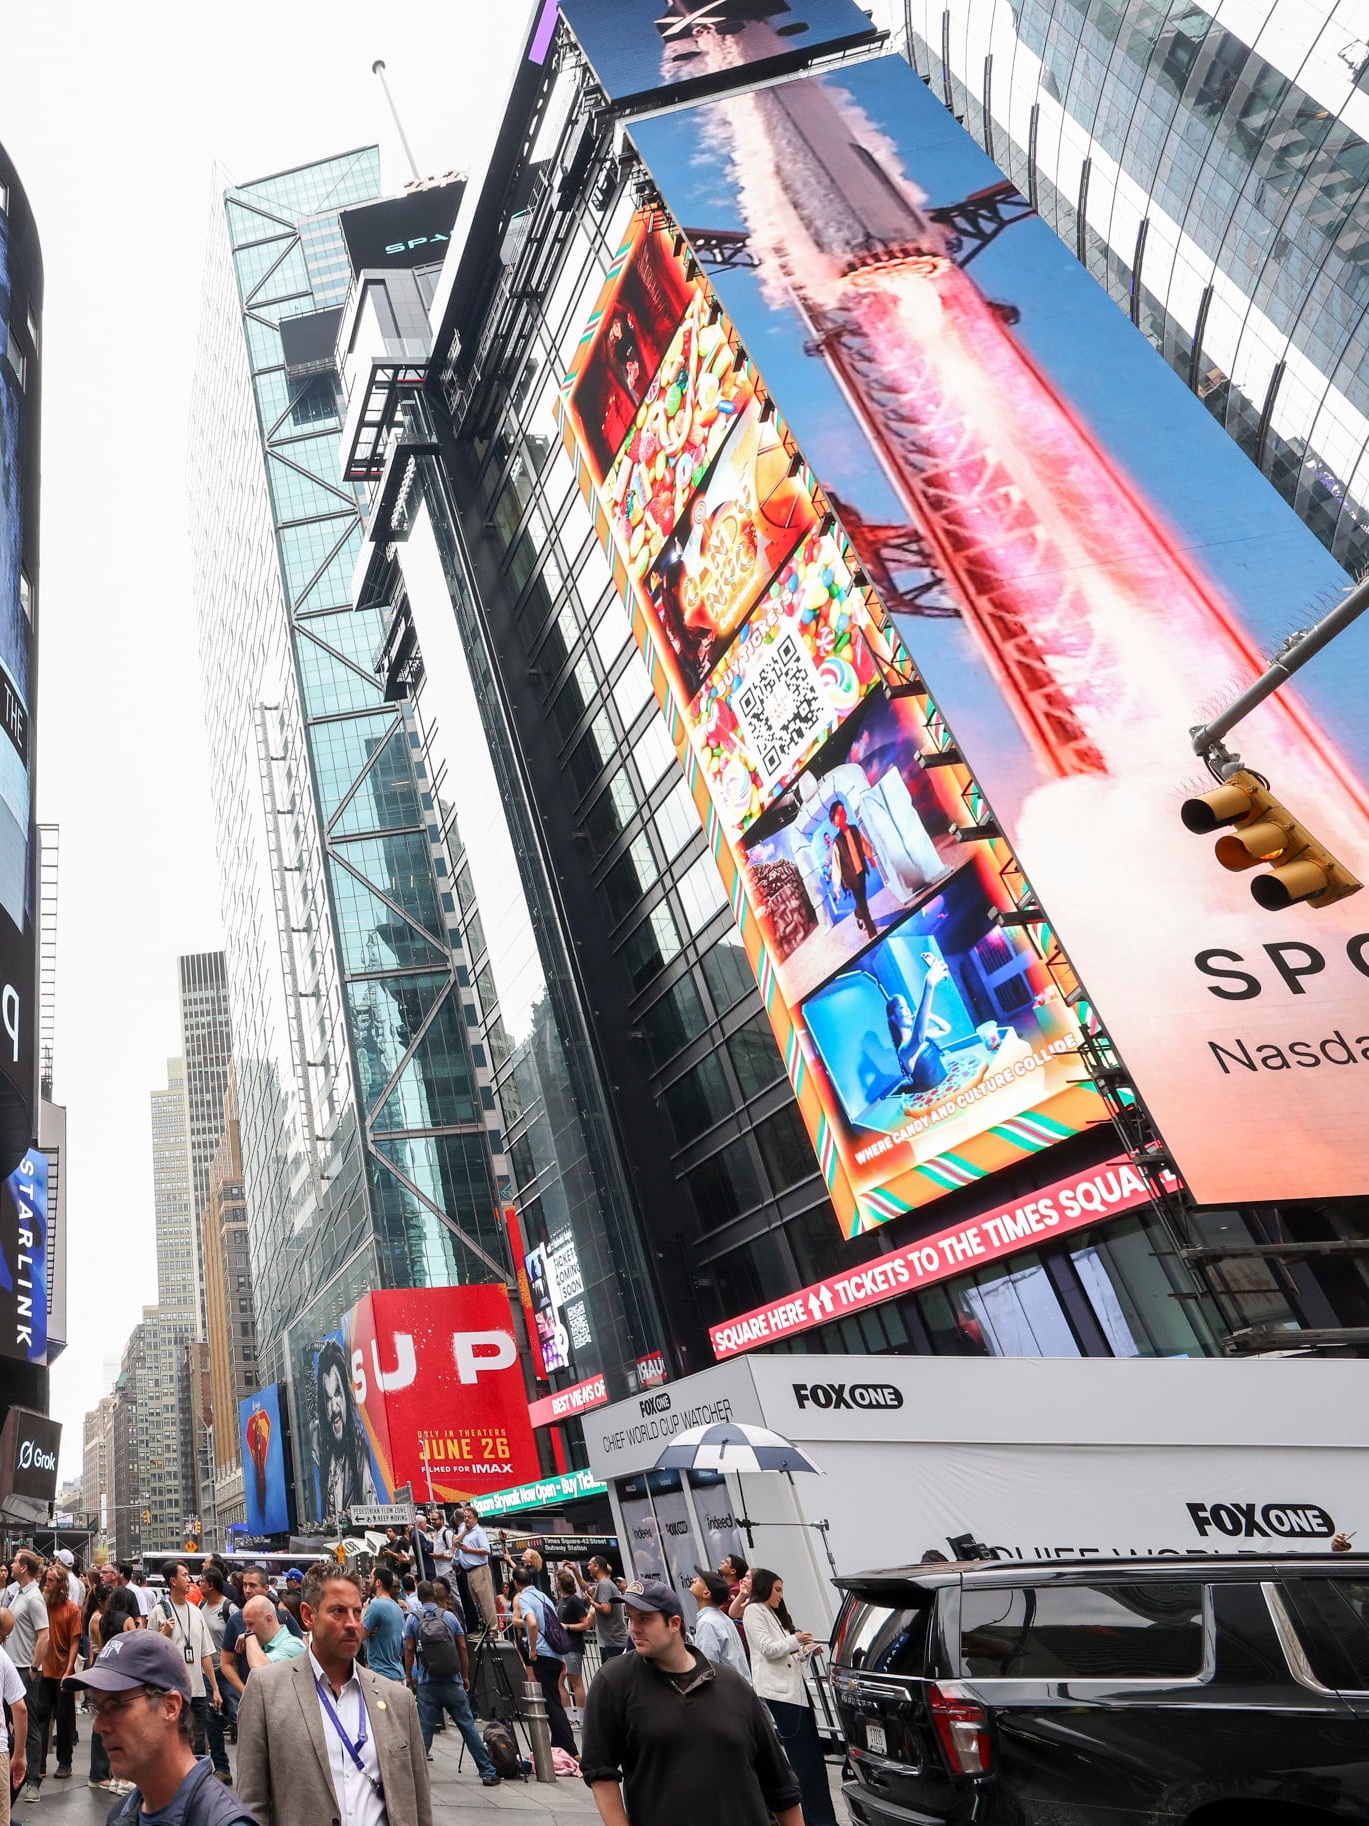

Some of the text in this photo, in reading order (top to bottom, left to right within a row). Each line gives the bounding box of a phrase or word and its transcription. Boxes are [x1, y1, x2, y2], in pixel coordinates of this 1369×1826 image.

[385, 230, 455, 255] SPA
[717, 589, 794, 697] BUY TICKETS
[4, 683, 23, 748] THE
[855, 1032, 1078, 1166] WHERE CANDY AND CULTURE COLLIDE
[16, 1158, 33, 1348] STARLINK
[554, 1247, 578, 1270] TICKET
[715, 1164, 1177, 1352] SQUARE HERE TICKETS TO THE TIMES SQUA
[562, 1278, 582, 1300] SOON
[552, 1378, 606, 1415] BEST VIEWS OF
[639, 1393, 670, 1418] FOX ONE
[792, 1384, 900, 1409] FOX ONE
[444, 1429, 454, 1437] IN
[459, 1428, 507, 1437] THEATERS
[603, 1398, 733, 1453] CHIEF WORLD CUP WATCHER
[34, 1448, 56, 1472] Grok
[419, 1438, 510, 1460] JUNE 26
[472, 1463, 514, 1473] IMAX
[519, 1485, 536, 1503] Now
[535, 1481, 556, 1504] Open
[560, 1477, 578, 1498] Buy
[353, 1506, 407, 1515] PEDESTRIAN FLOW ZONE
[707, 1513, 733, 1530] indeed
[1186, 1503, 1328, 1537] FOX ONE
[544, 1537, 560, 1545] Times
[544, 1544, 566, 1552] Subway
